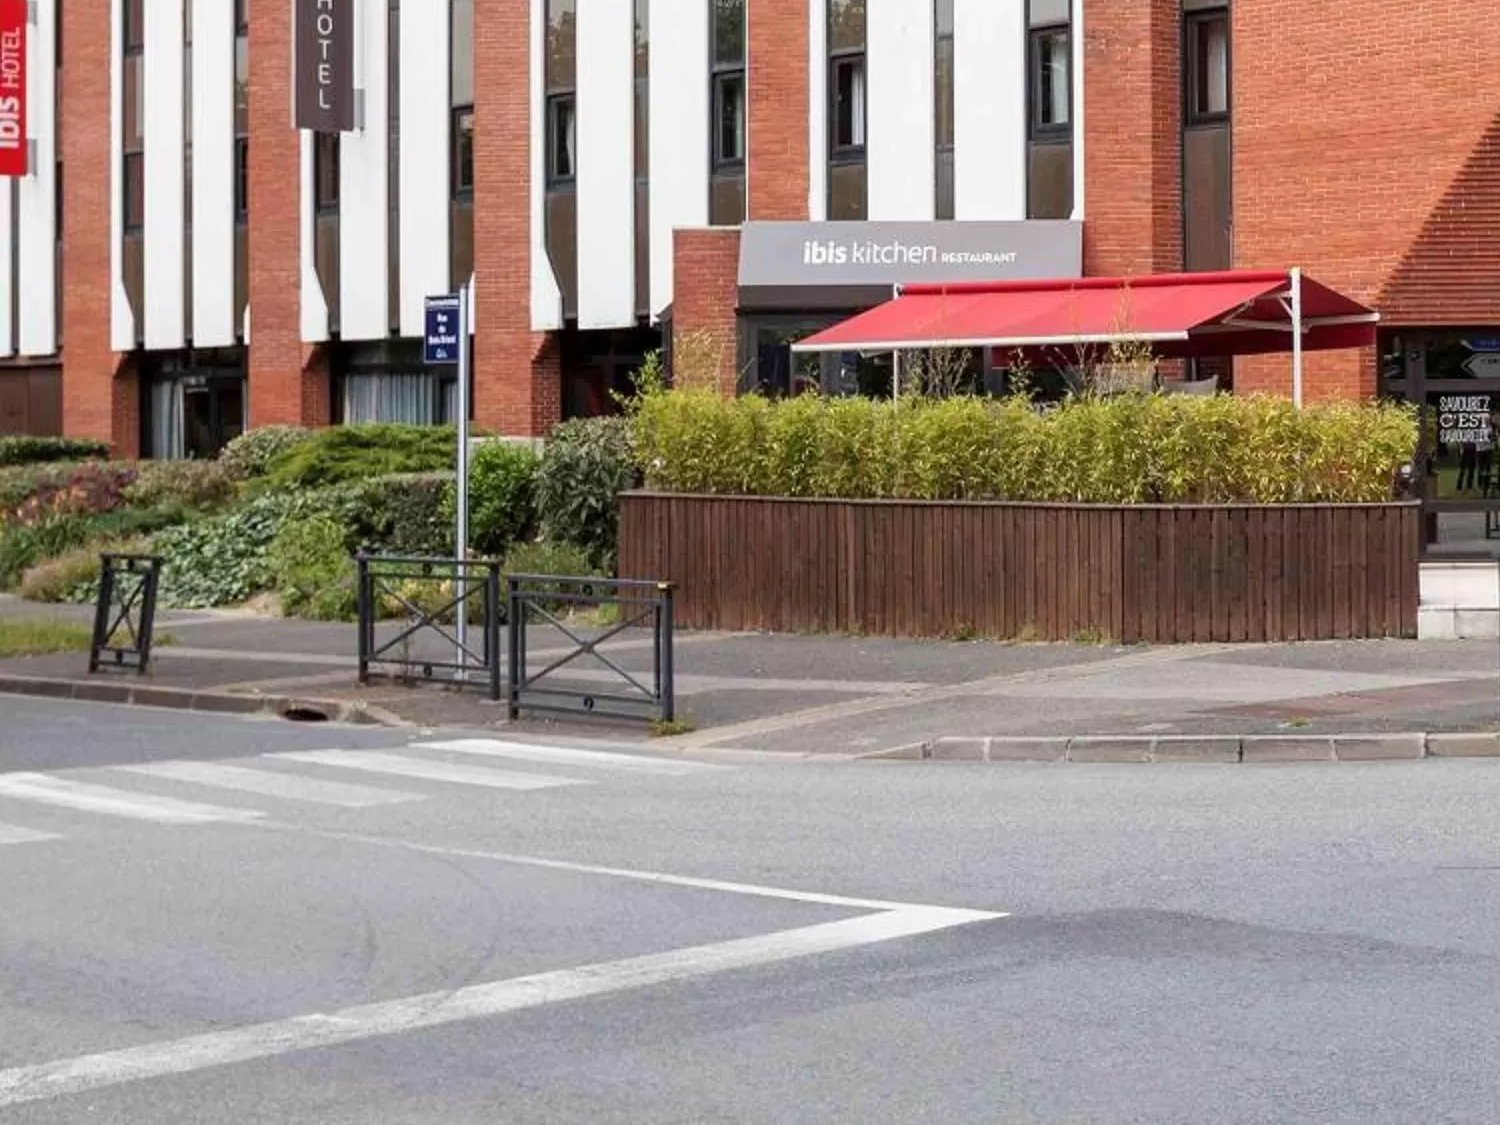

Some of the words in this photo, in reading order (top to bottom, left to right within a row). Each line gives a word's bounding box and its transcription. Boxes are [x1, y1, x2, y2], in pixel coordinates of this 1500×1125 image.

[1, 26, 20, 89] HOTEL
[803, 241, 847, 265] ibis
[852, 241, 936, 264] kitchen
[941, 251, 1017, 264] RESTAURANT
[1440, 413, 1491, 428] C'EST
